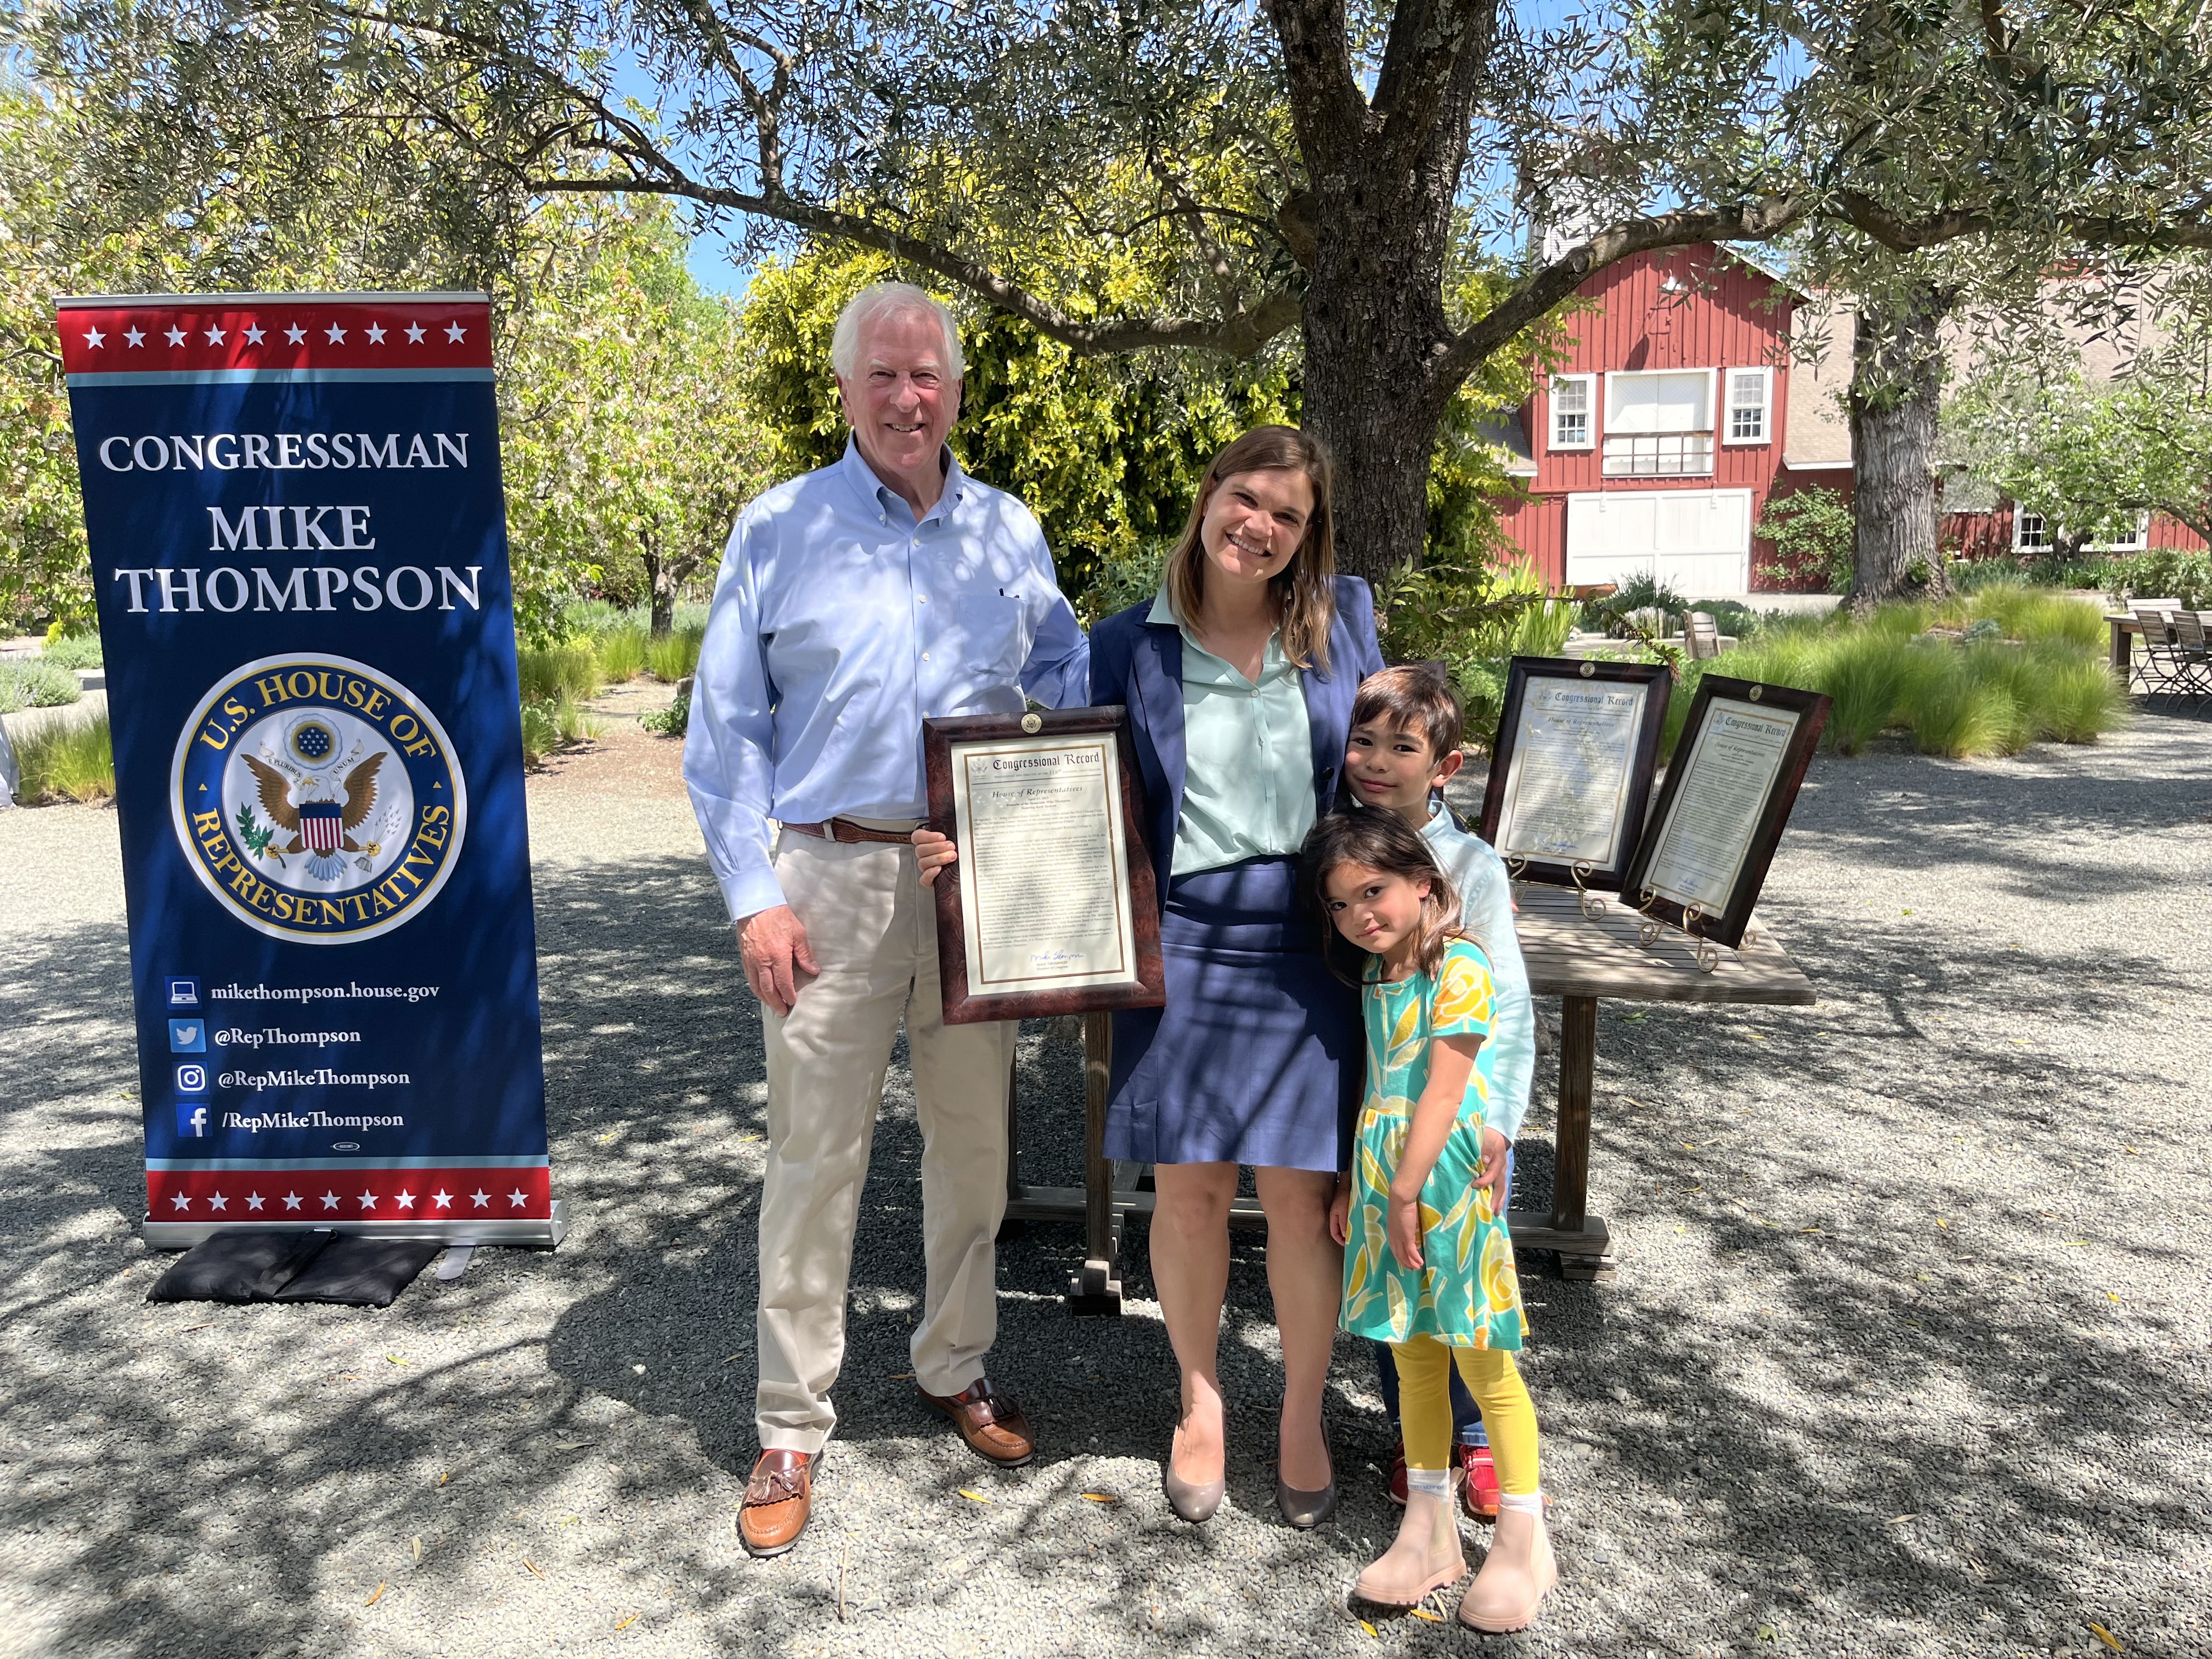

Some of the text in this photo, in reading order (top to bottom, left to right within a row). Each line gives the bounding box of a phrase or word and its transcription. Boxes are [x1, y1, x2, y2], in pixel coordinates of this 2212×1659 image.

[100, 433, 469, 472] CONGRESSMAN
[206, 506, 376, 551] MIKE
[115, 566, 483, 613] THOMPSON
[1555, 692, 1633, 706] Congressional Record
[199, 671, 437, 758] U.S. HOUSE OF
[1725, 716, 1764, 732] Congressional
[1765, 724, 1787, 737] Record
[274, 760, 302, 778] PLURIBUS
[333, 757, 354, 774] UNUM
[993, 752, 1099, 771] Congressional Record
[1017, 788, 1025, 797] of
[1027, 786, 1082, 795] Representatives
[193, 804, 450, 925] REPRESENTATIVES
[211, 981, 440, 1004] mikethompson.house.gov
[215, 1028, 362, 1049] @RepThompson
[218, 1068, 410, 1091] @RepMikeThompson
[222, 1110, 404, 1133] /RepMikeThompson
